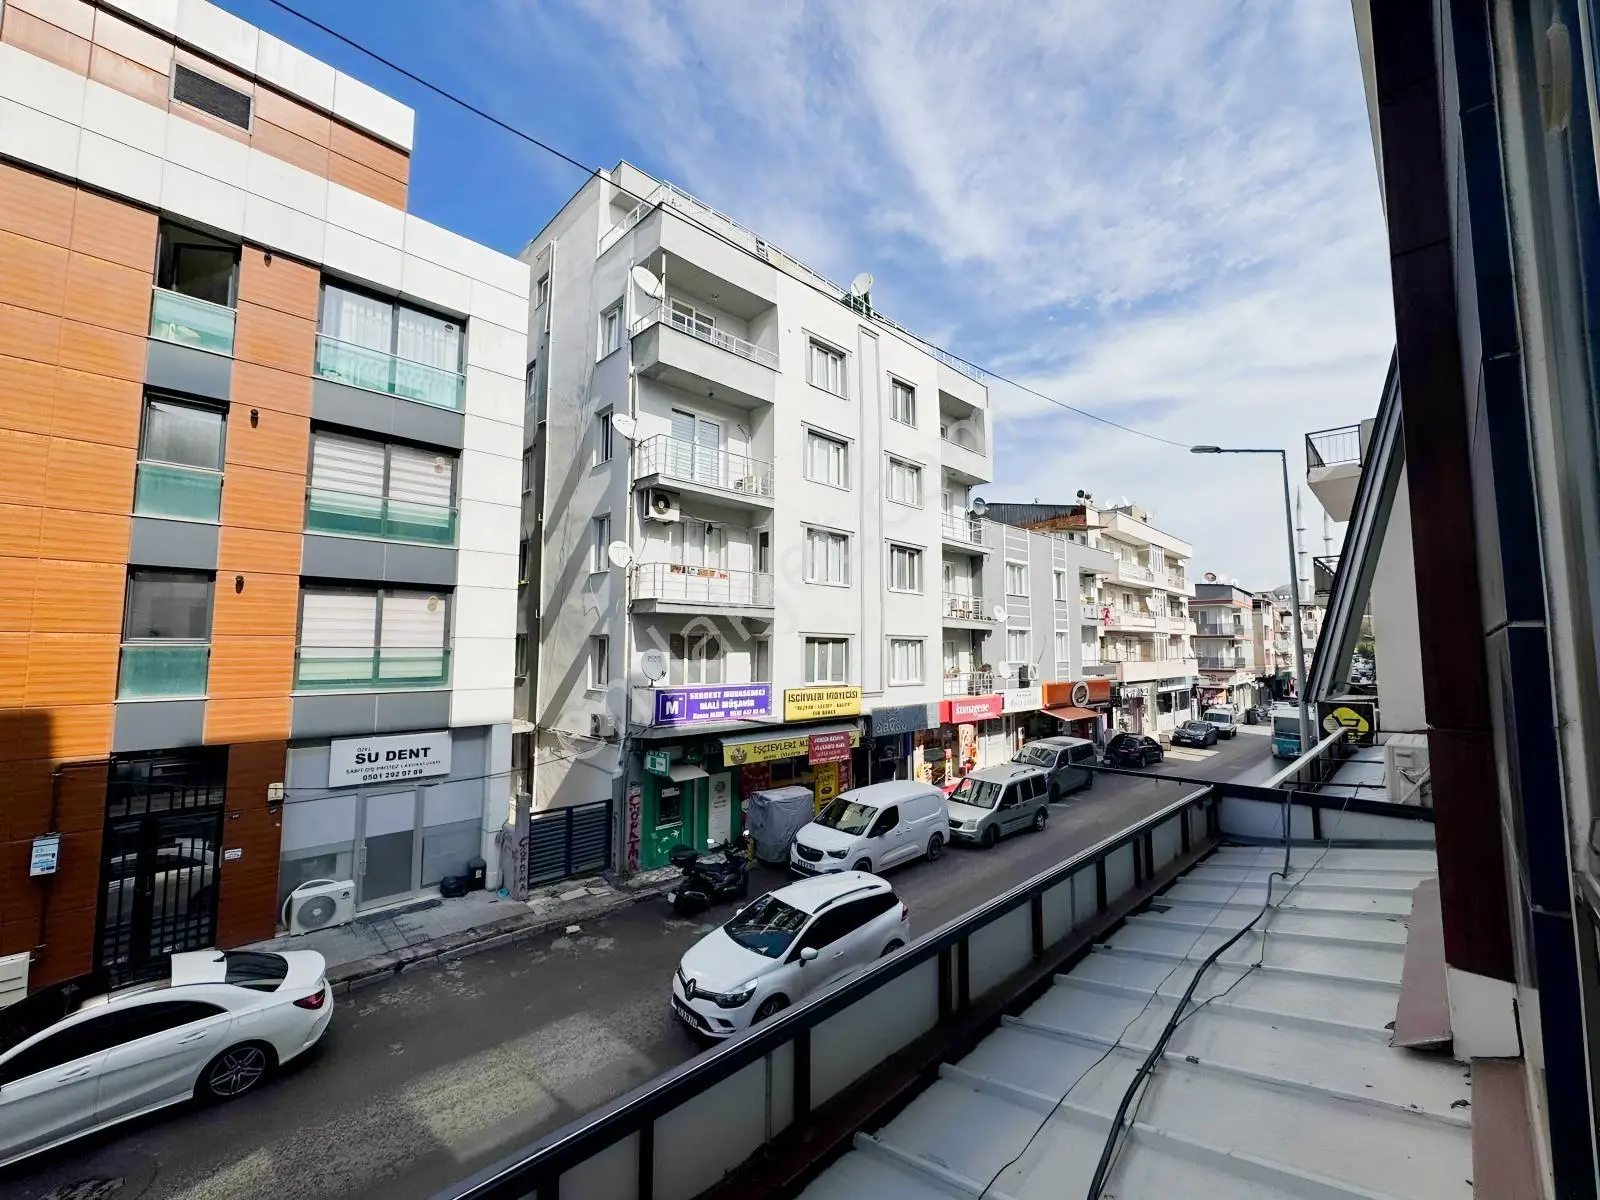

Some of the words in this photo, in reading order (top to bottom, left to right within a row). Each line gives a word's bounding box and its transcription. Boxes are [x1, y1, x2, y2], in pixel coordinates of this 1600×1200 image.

[354, 752, 379, 765] SU
[385, 747, 432, 762] DENT
[362, 773, 383, 781] 0501
[385, 771, 400, 779] 292
